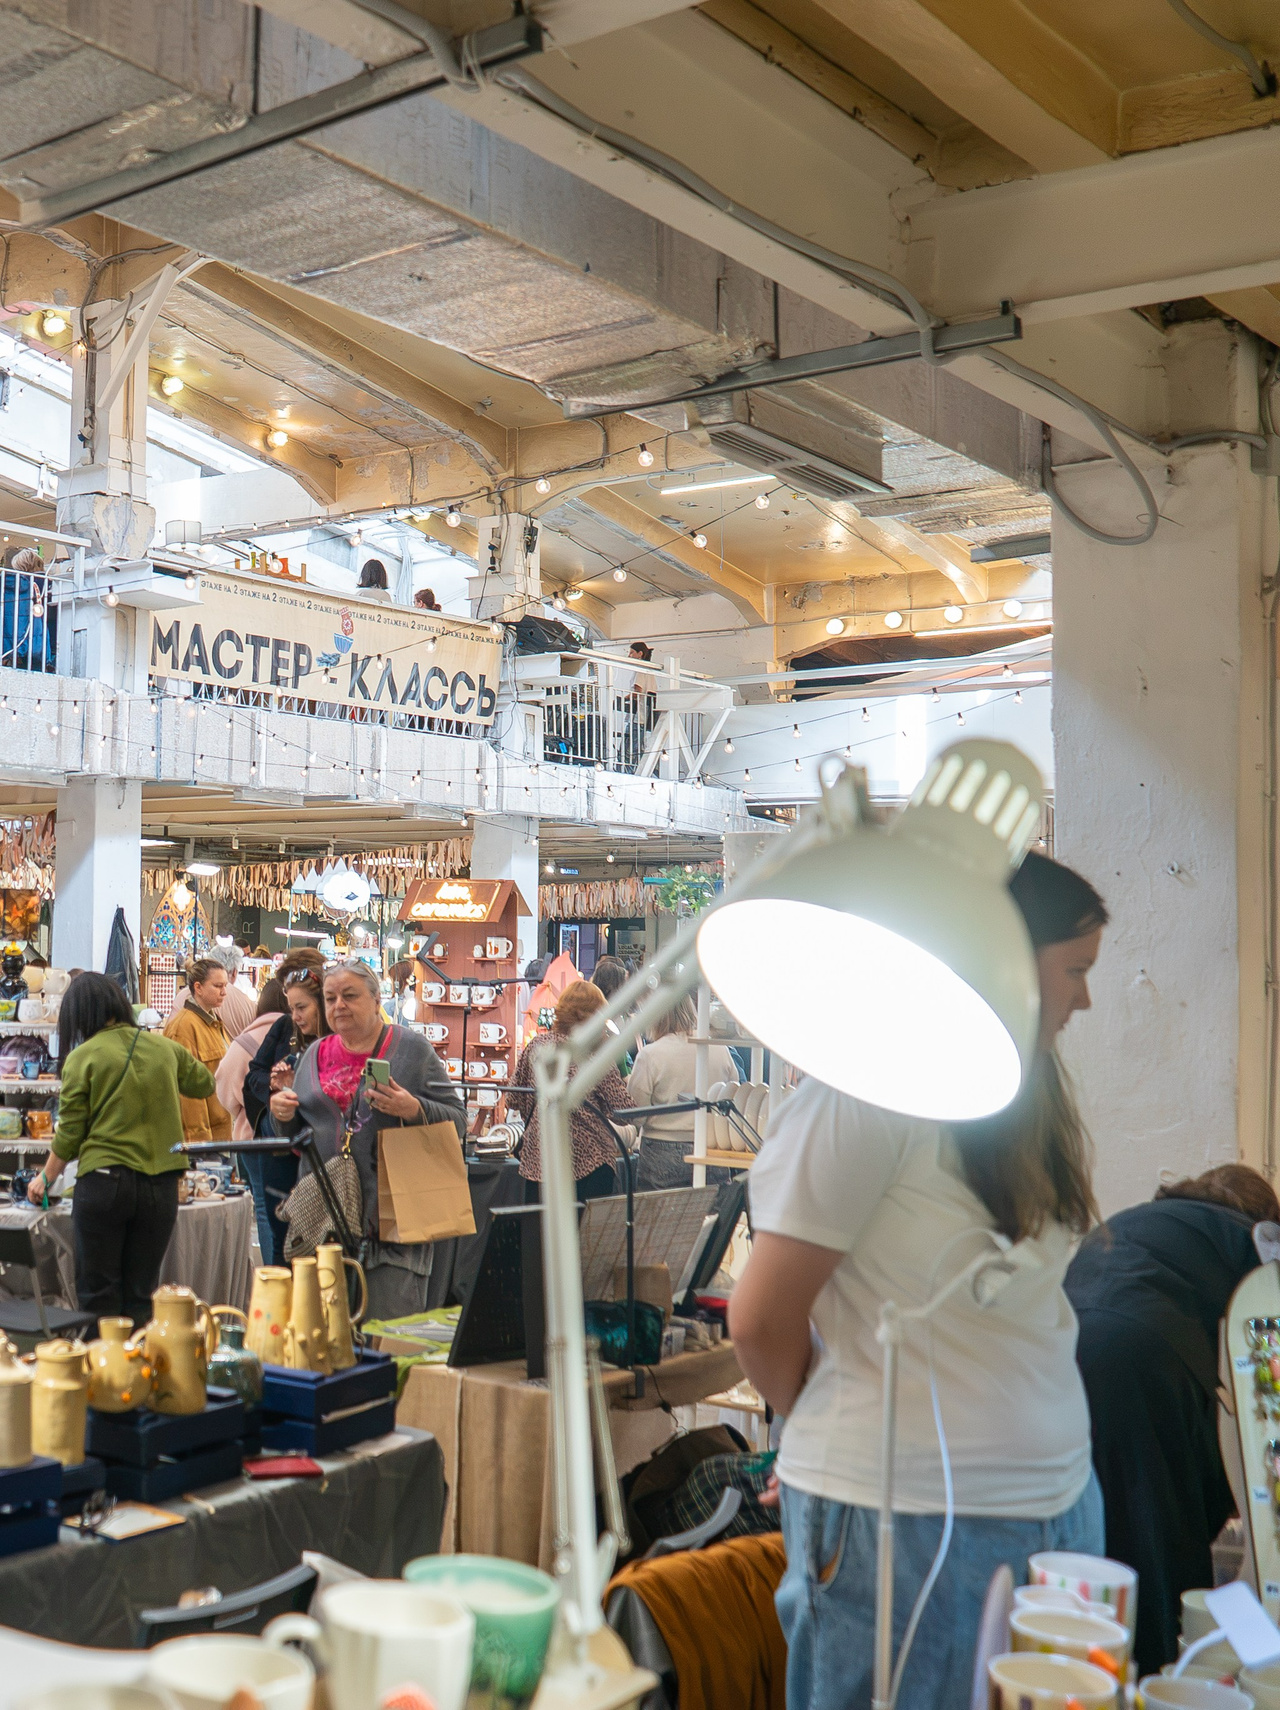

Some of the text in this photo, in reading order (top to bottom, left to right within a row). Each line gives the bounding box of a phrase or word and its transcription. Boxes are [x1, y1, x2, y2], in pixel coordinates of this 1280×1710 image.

[200, 580, 222, 591] ЭТАЖЕ
[224, 585, 231, 593] НА
[233, 584, 238, 595] 2
[240, 588, 261, 599] ЭТАЖЕ
[262, 593, 270, 601] НА
[272, 592, 277, 602] 2
[279, 596, 298, 606] ЭТАЖЕ
[299, 600, 305, 608] НА
[307, 600, 312, 610] 2
[313, 603, 332, 614] ЭТАЖЕ
[333, 607, 340, 615] НА
[349, 611, 367, 621] ЭТАЖЕ
[376, 614, 382, 623] 2
[383, 617, 401, 627] ЭТАЖЕ
[410, 620, 416, 630] 2
[417, 623, 435, 633] ЭТАЖЕ
[442, 626, 446, 635] 2
[471, 632, 475, 641] 2
[475, 636, 494, 644] ЭТАЖЕ
[151, 616, 313, 689] МАСТЕР
